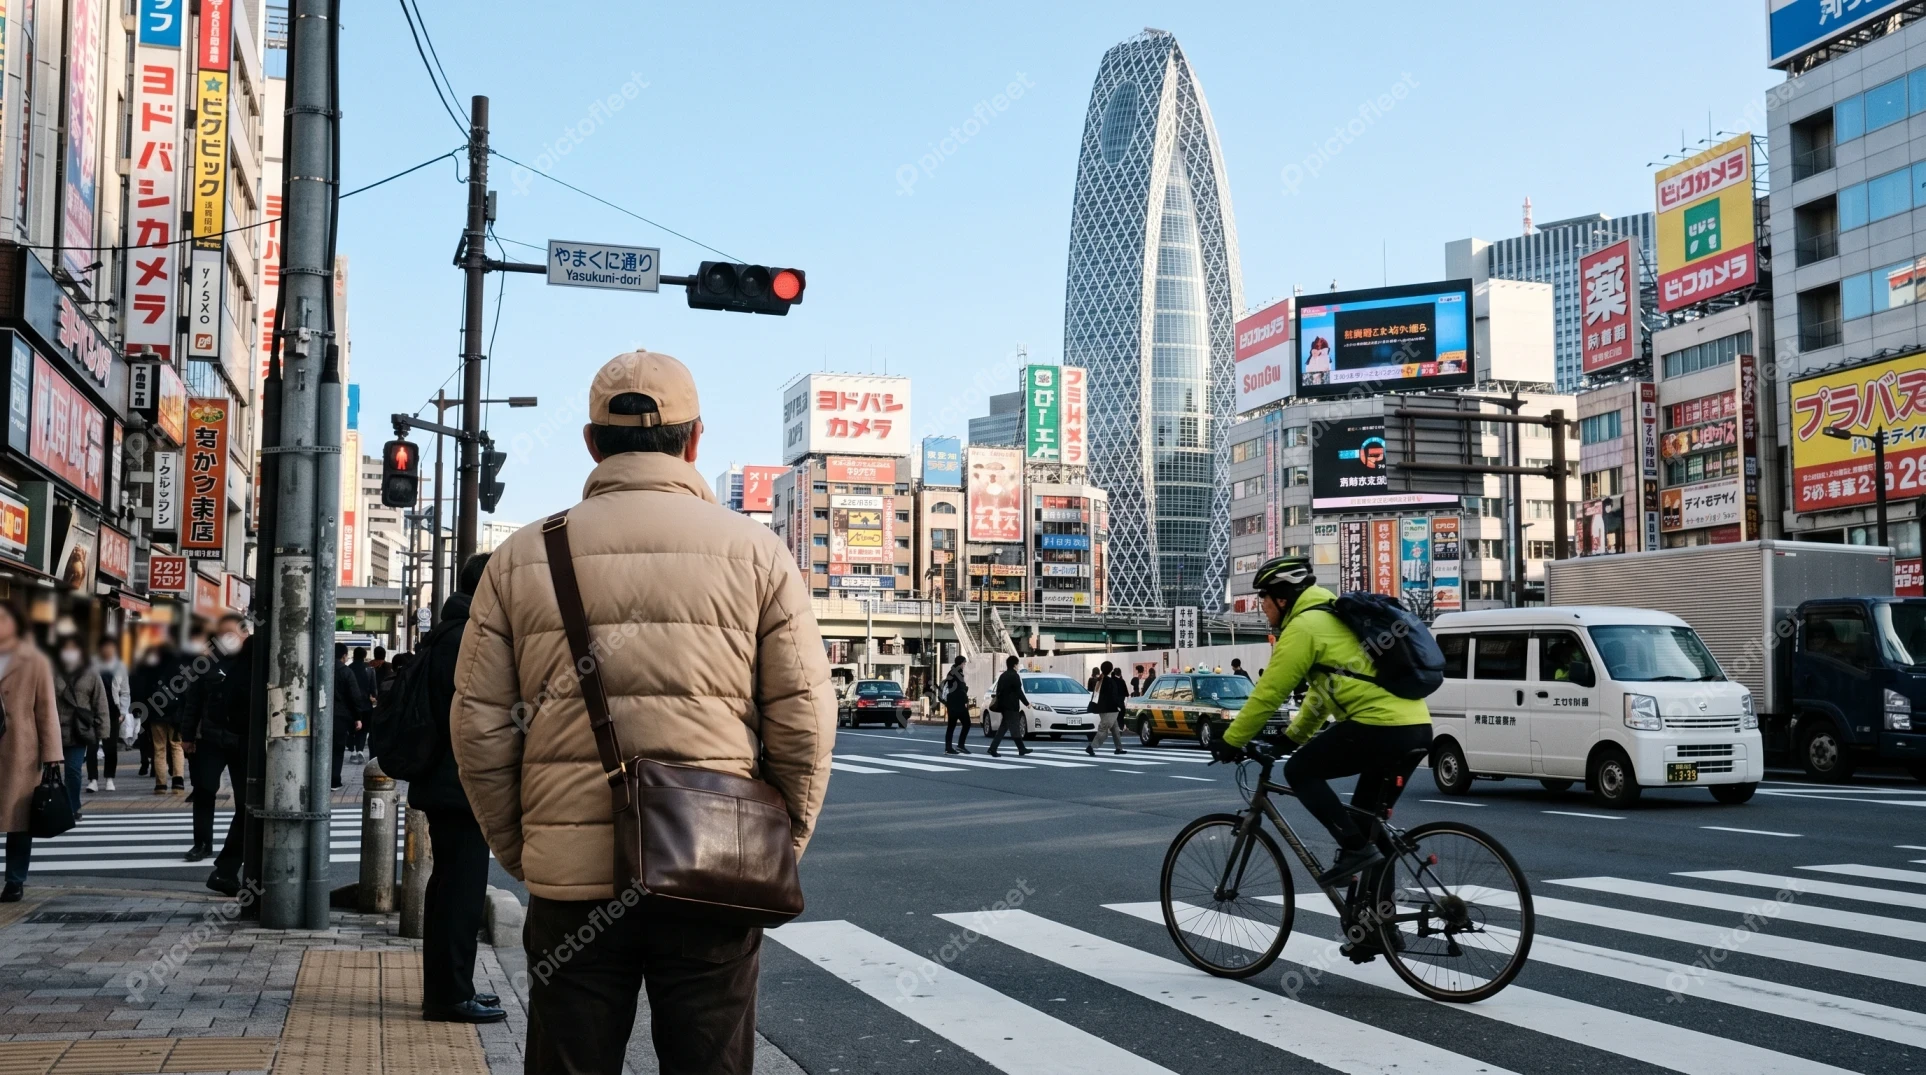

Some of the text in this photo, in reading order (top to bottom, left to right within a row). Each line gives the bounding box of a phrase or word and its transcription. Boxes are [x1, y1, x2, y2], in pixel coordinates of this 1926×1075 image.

[134, 65, 175, 325] ヨドバシカメラ
[554, 247, 653, 273] やまくに通り
[566, 269, 642, 286] Yasukuni-dori
[1584, 254, 1627, 327] 薬
[816, 390, 904, 413] ヨドバシ
[826, 417, 893, 440] カメラ
